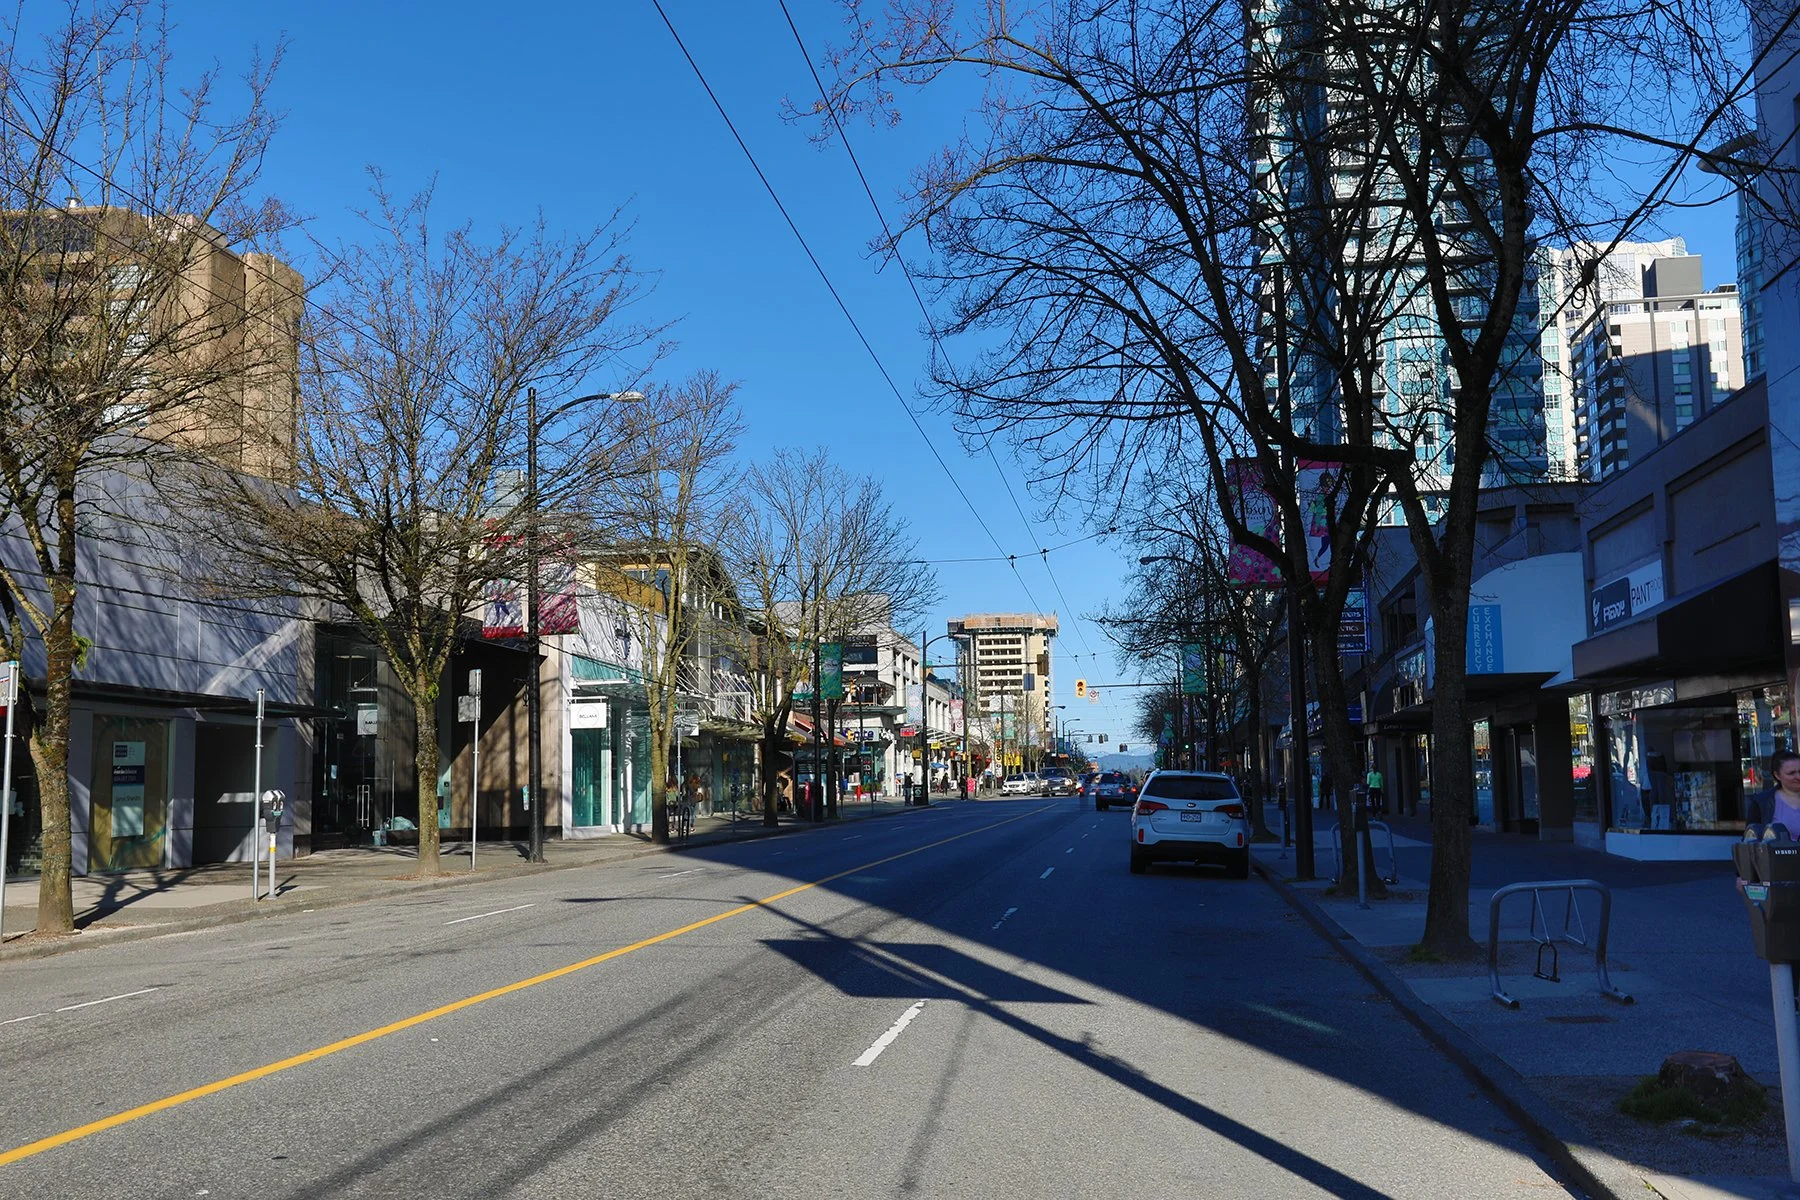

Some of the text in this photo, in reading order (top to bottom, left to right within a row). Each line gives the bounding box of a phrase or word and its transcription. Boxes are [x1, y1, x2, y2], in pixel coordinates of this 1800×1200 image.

[1631, 581, 1650, 607] PANT
[1472, 607, 1482, 672] CURRENCY
[1483, 607, 1494, 672] EXCHANGE
